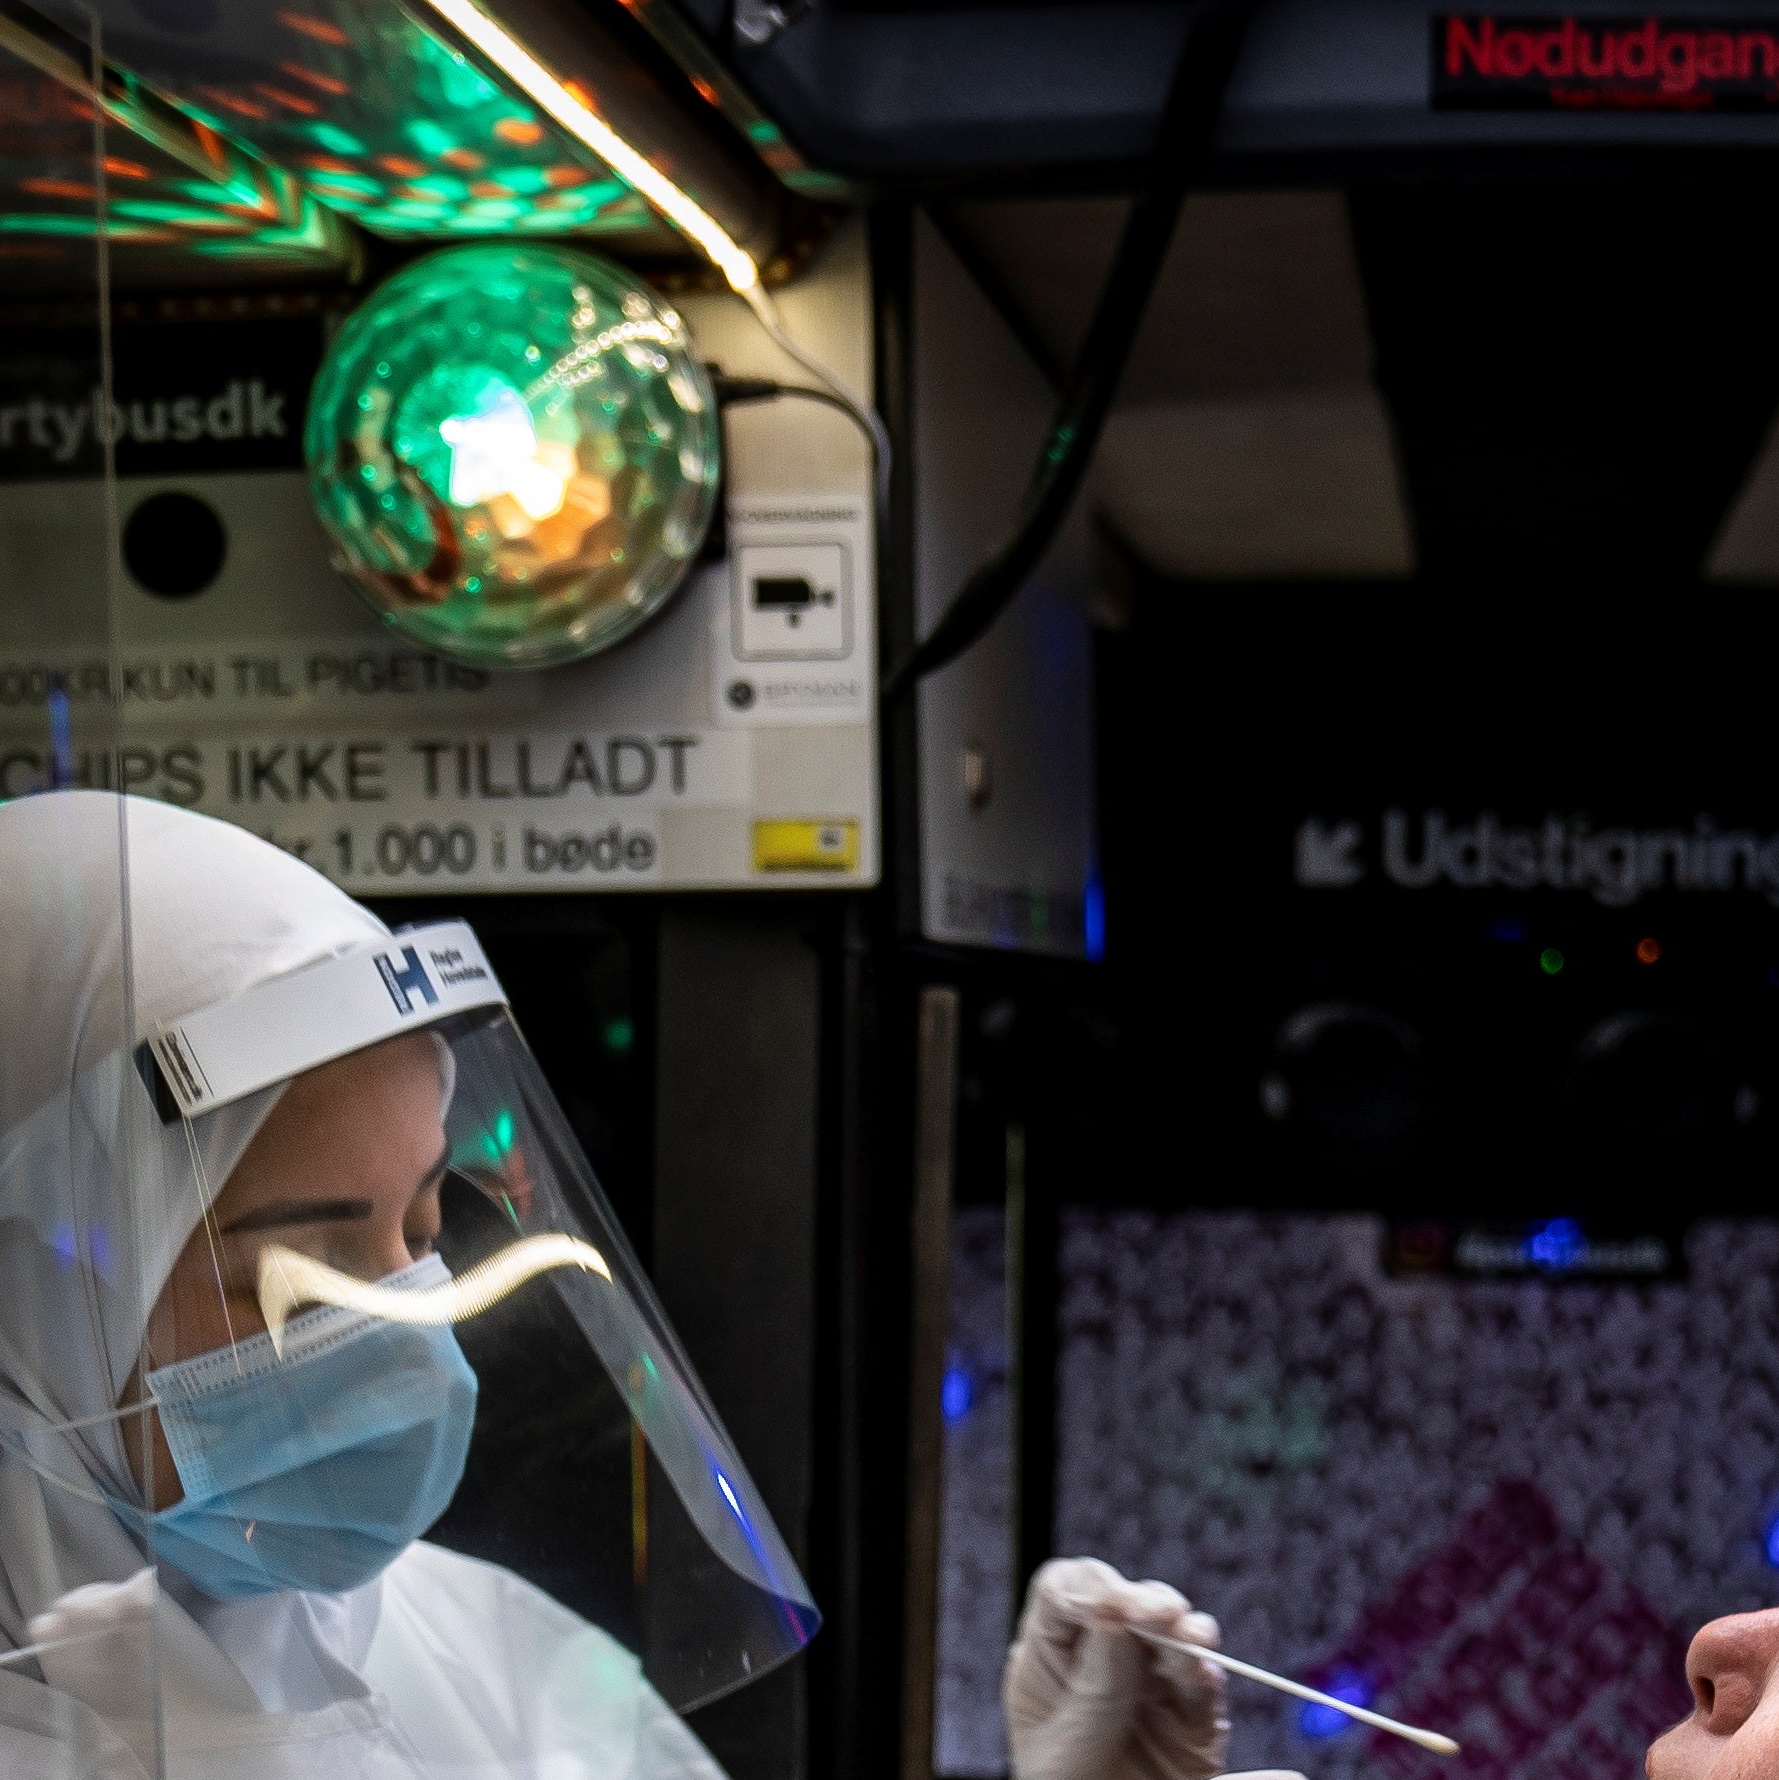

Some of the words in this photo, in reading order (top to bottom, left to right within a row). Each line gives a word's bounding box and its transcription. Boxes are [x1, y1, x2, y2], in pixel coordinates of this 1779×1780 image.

[229, 656, 295, 698] TIL
[227, 738, 388, 803] IKKE
[408, 734, 699, 801] TILLADT
[491, 825, 509, 871] i
[524, 825, 658, 875] bøde
